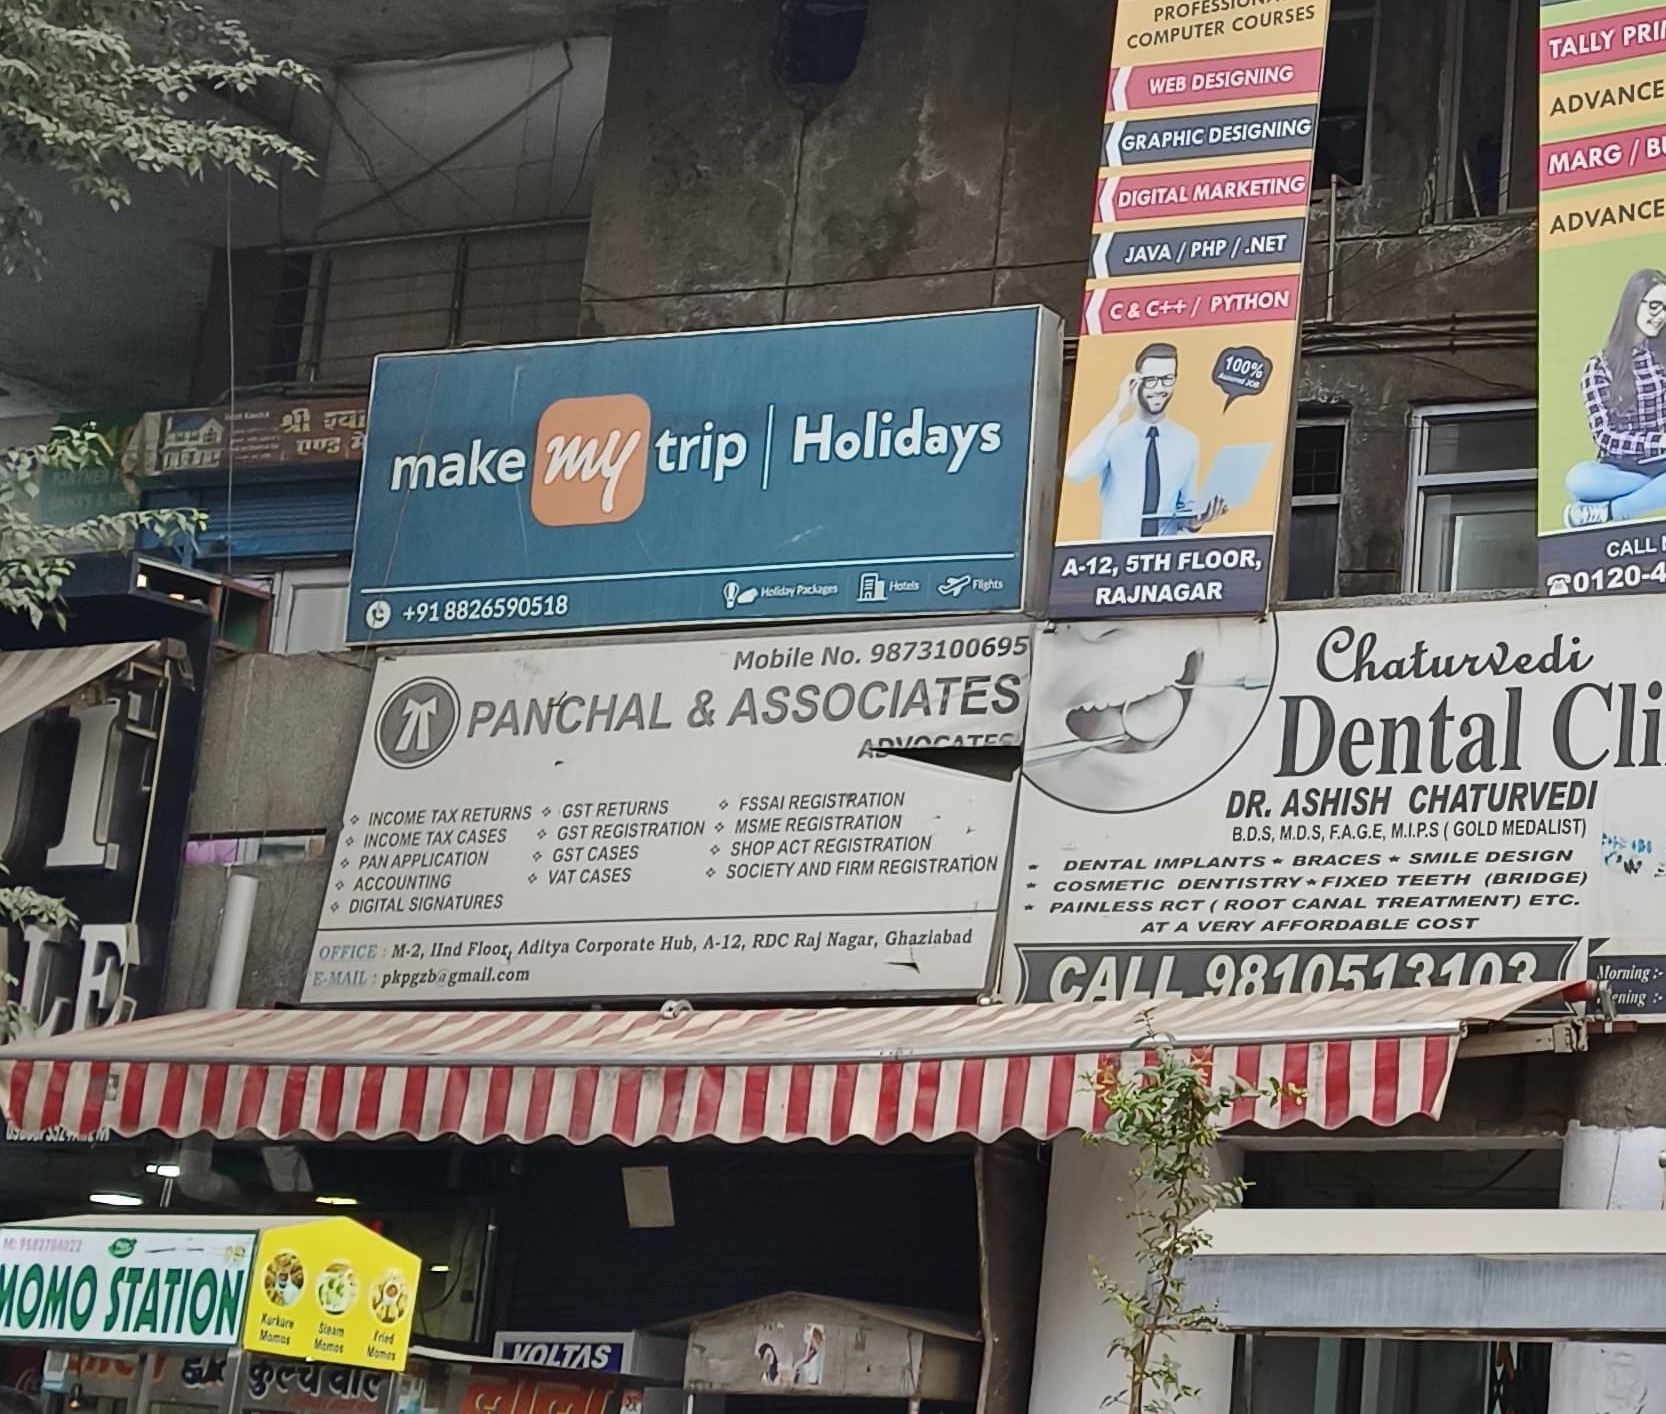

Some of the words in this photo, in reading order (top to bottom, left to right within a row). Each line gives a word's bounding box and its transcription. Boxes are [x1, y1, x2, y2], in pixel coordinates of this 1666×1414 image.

[1127, 21, 1224, 49] COMPUTER
[1232, 5, 1315, 32] COURSES
[1225, 355, 1264, 379] 100%
[391, 439, 526, 491] make
[544, 430, 642, 512] my
[655, 421, 746, 481] trip
[792, 407, 1002, 472] Holidays
[761, 584, 794, 601] Holiday
[797, 580, 838, 598] Packages
[890, 578, 919, 593] Hotels
[973, 577, 1003, 594] Flights
[733, 646, 813, 672] Mobile
[822, 644, 861, 668] No.
[869, 636, 1029, 664] 9873100695
[1316, 625, 1594, 684] Chaturvedi
[468, 691, 671, 739] PANCHAL
[686, 689, 715, 728] &
[727, 674, 1020, 727] ASSOCIATES
[1274, 686, 1524, 779] Dental
[739, 796, 784, 812] FSSAI
[788, 791, 905, 809] REGISTRATION
[1226, 790, 1272, 819] DR.
[1280, 786, 1391, 817] ASHISH
[1409, 779, 1599, 815] CHATURVEDI
[368, 811, 426, 826] INCOME
[429, 808, 458, 825] TAX
[462, 804, 532, 823] RETURNS
[730, 840, 775, 856] SHOP
[776, 839, 806, 854] ACT
[810, 836, 932, 853] REGISTRATION
[1063, 857, 1148, 873] DENTAL
[1152, 855, 1266, 870] IMPLANTS
[1292, 852, 1381, 867] BRACES
[1408, 849, 1481, 864] SMILE
[1485, 848, 1574, 863] DESIGN
[348, 898, 406, 913] DIGITAL
[409, 894, 503, 912] SIGNATURES
[1140, 919, 1166, 935] AT
[1174, 919, 1190, 933] A
[1198, 918, 1254, 933] VERY
[1260, 916, 1410, 932] AFFORDABLE
[1418, 915, 1479, 931] COST
[1597, 965, 1650, 982] Morning
[0, 1263, 98, 1332] MOMO
[103, 1266, 244, 1335] STATION
